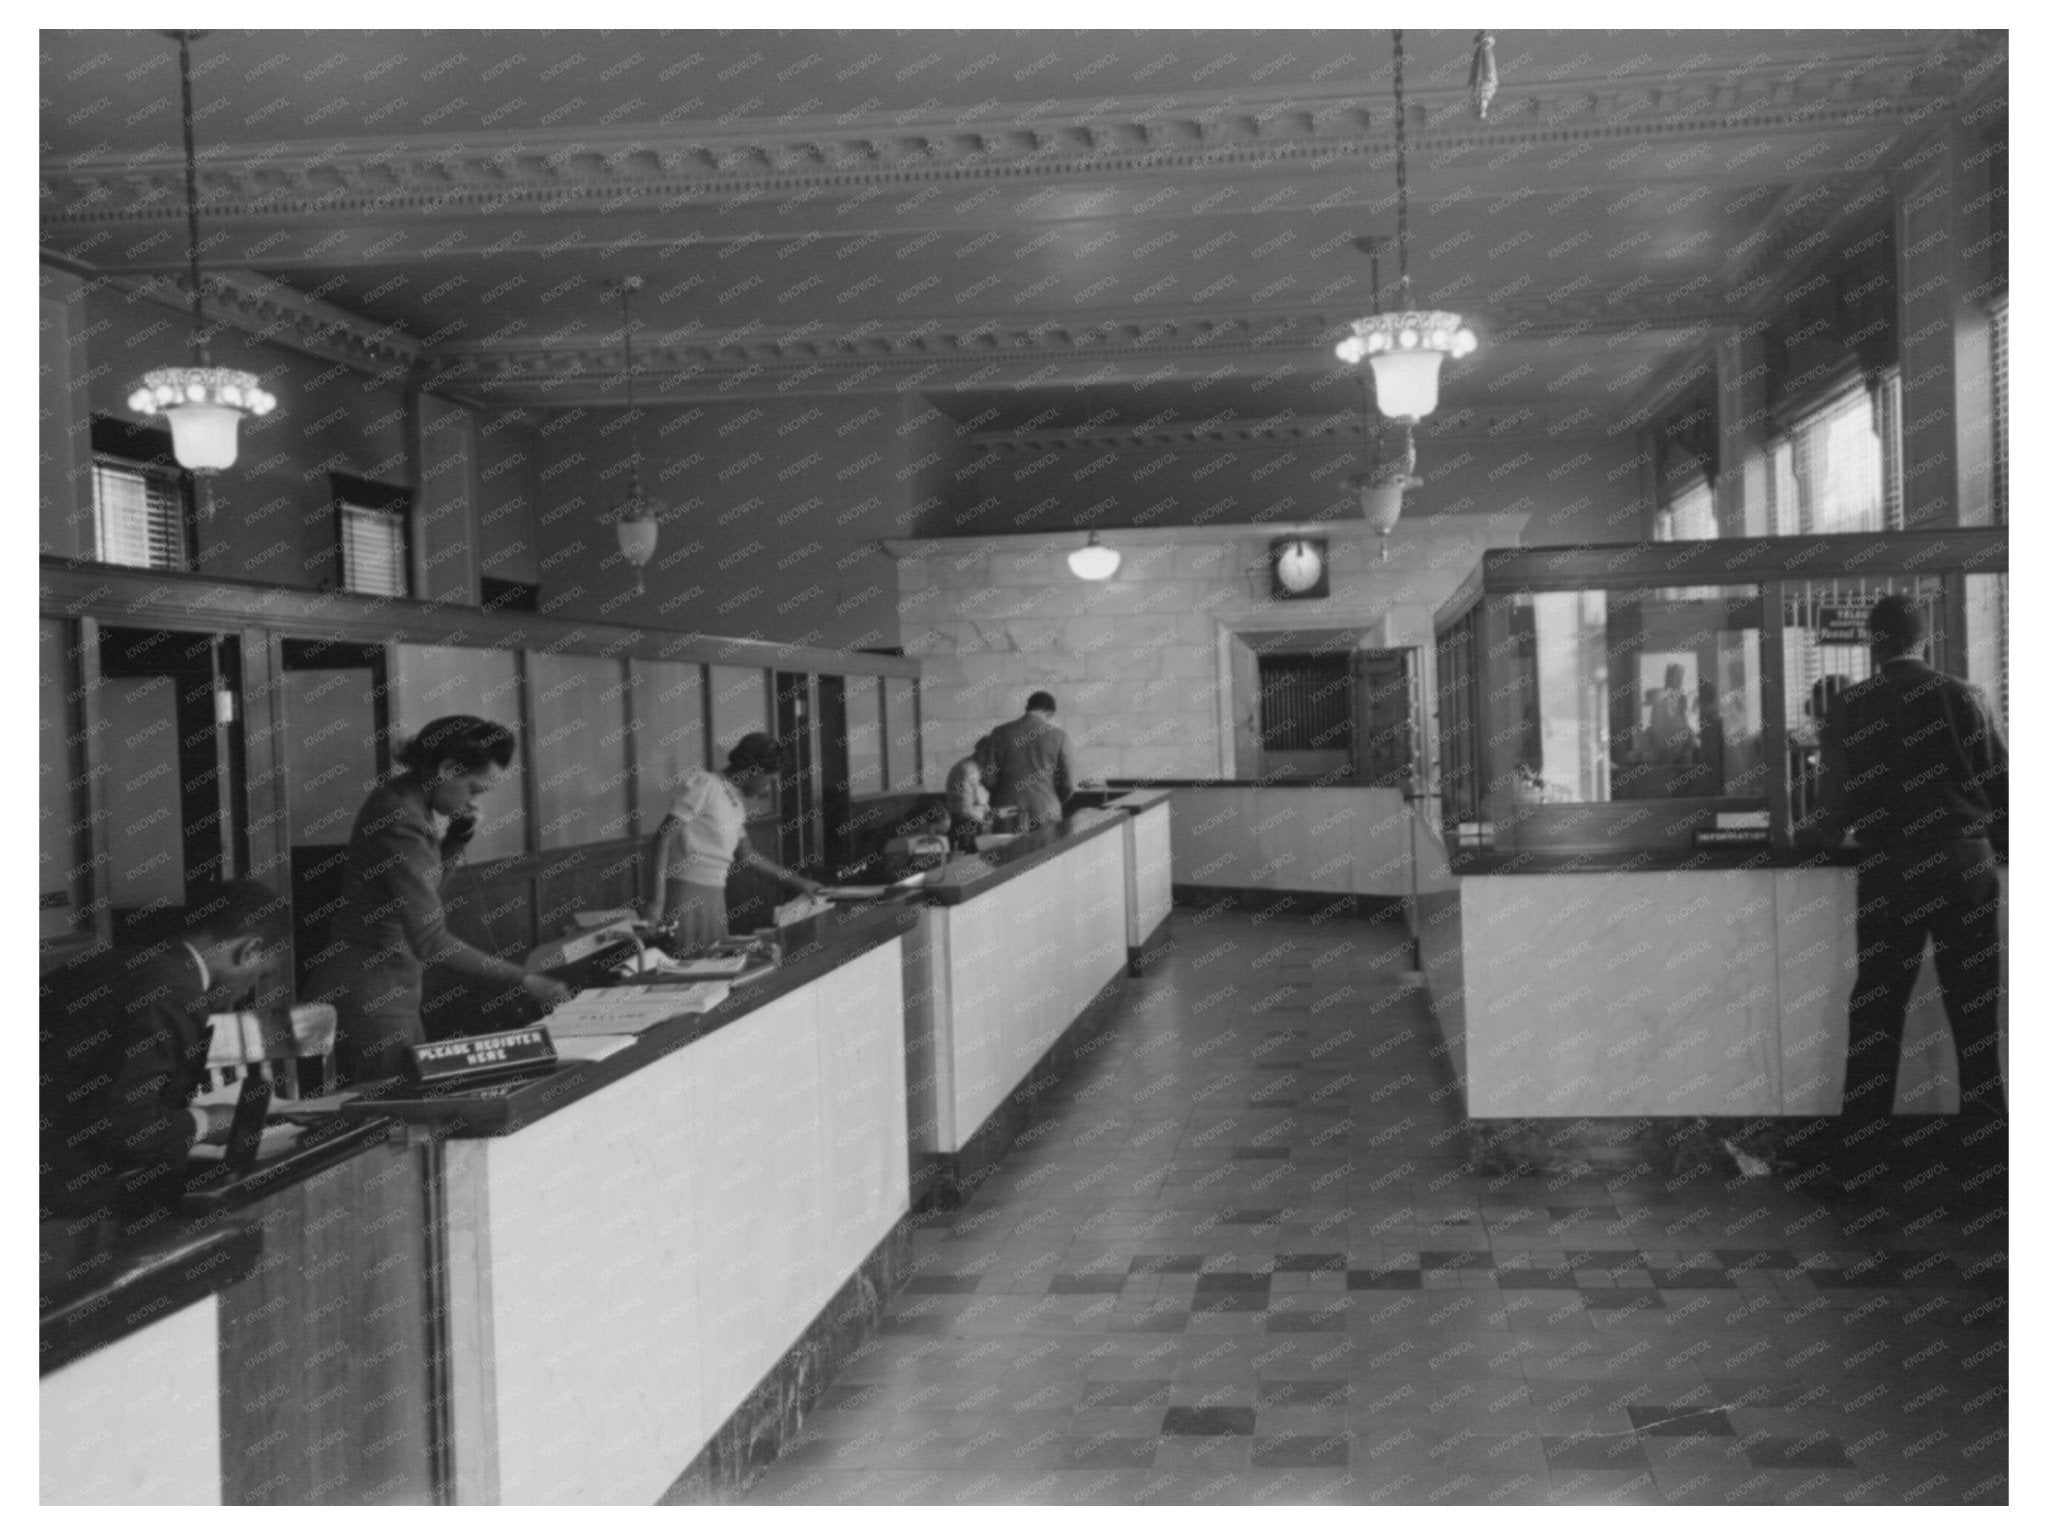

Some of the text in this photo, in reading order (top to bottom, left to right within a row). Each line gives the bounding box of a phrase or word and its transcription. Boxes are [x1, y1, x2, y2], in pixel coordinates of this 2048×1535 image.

[1697, 831, 1767, 841] INFORMATION
[417, 1031, 542, 1060] PLEASE REGISTER
[466, 1048, 507, 1065] HERE
